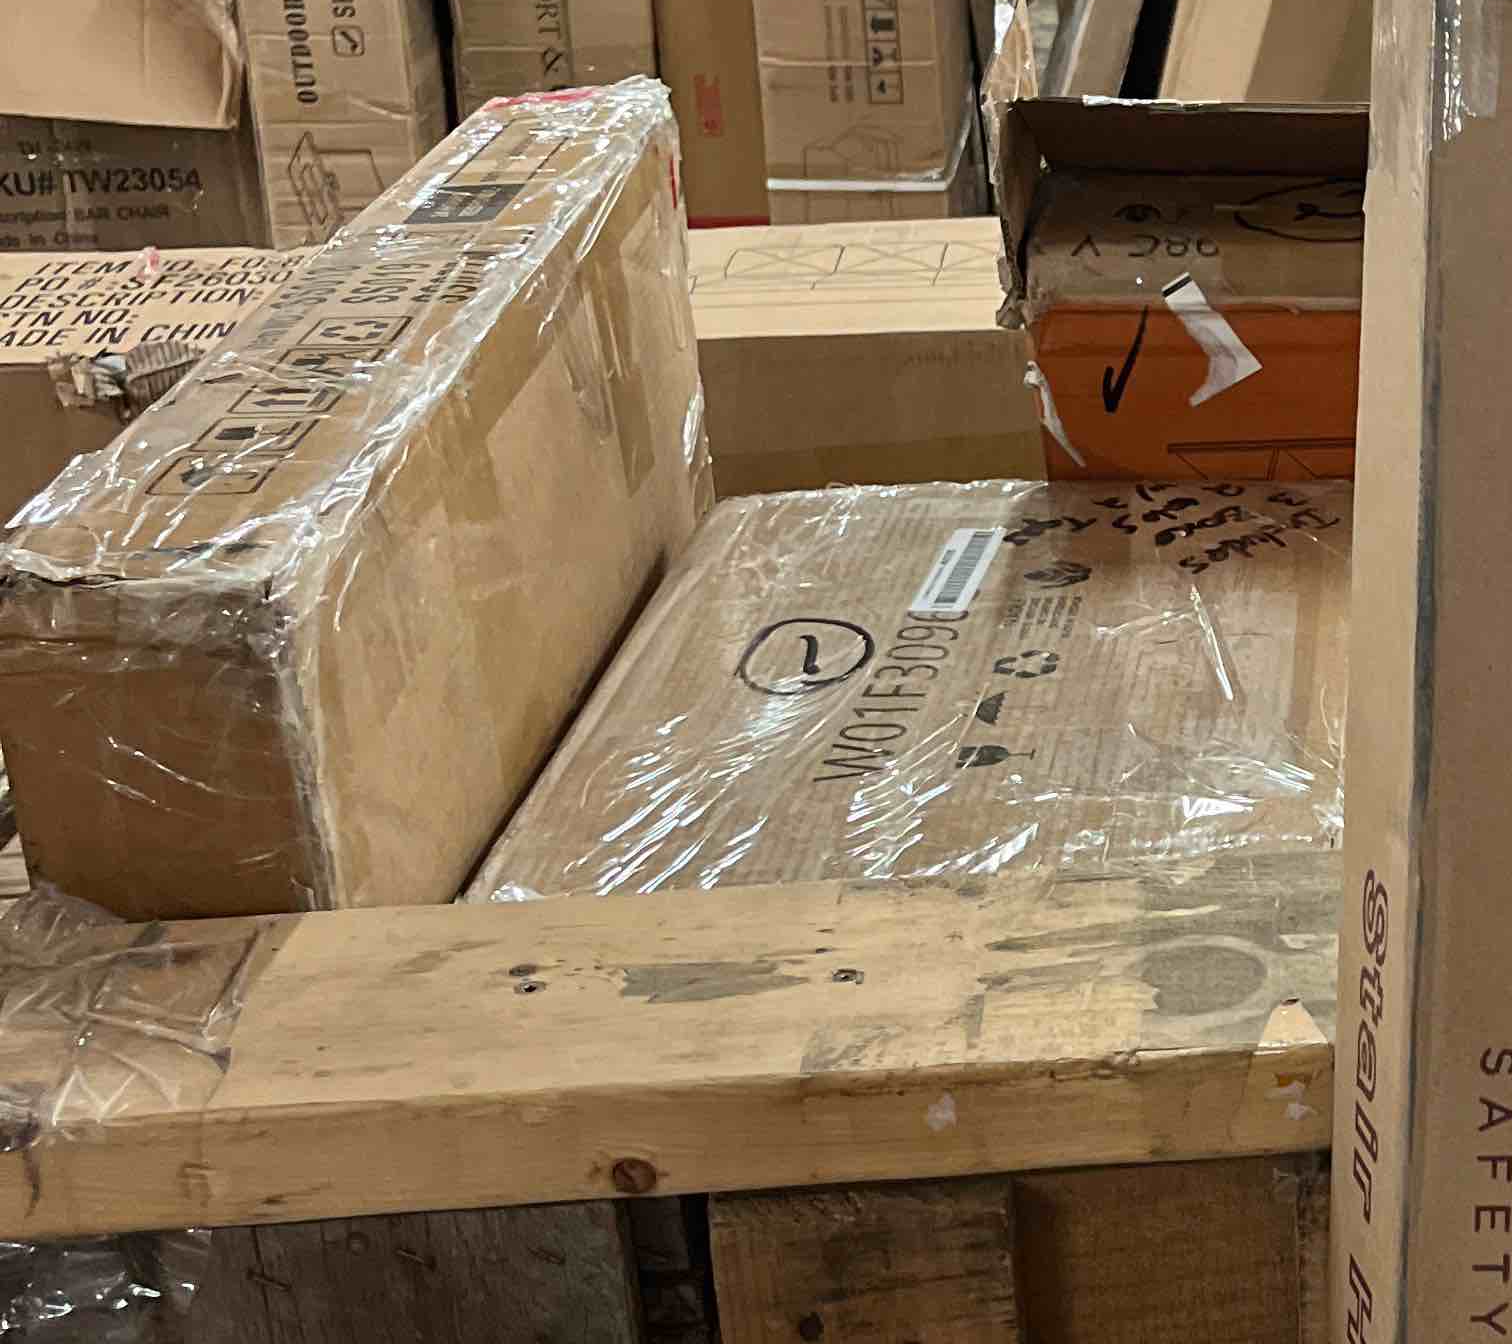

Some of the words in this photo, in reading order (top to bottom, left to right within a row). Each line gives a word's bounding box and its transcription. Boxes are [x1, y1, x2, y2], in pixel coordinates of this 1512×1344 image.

[0, 169, 52, 196] KU#
[34, 259, 135, 276] ITEM
[0, 288, 265, 310] DESCRIPTION:
[0, 311, 63, 328] TN
[0, 327, 77, 348] ADE
[84, 326, 131, 345] IN
[140, 320, 238, 344] CHIN
[1353, 867, 1389, 1224] Stair
